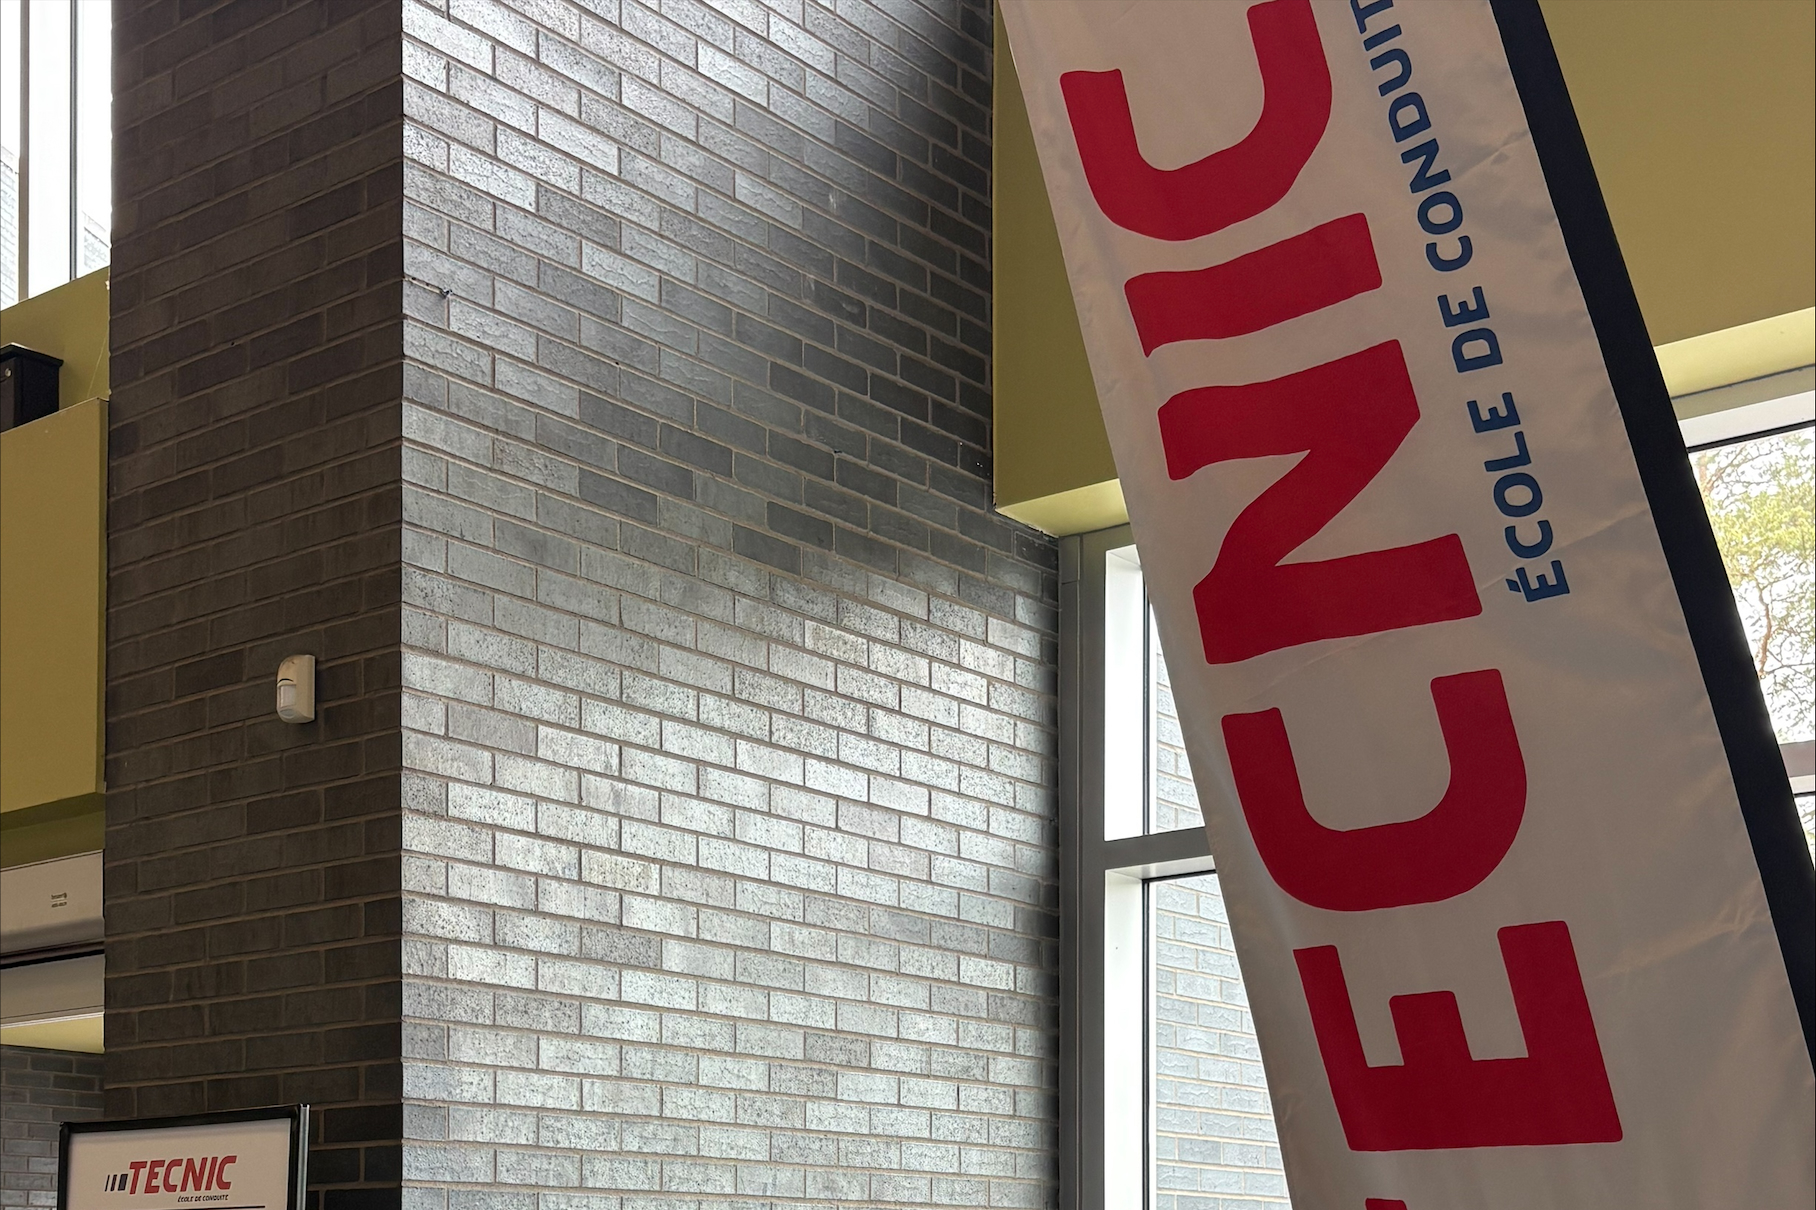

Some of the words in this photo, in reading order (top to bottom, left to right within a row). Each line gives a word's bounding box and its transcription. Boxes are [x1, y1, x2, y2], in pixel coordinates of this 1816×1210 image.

[1437, 287, 1502, 373] DE
[1468, 393, 1570, 602] ÉCOLE
[129, 1155, 237, 1195] TECNIC
